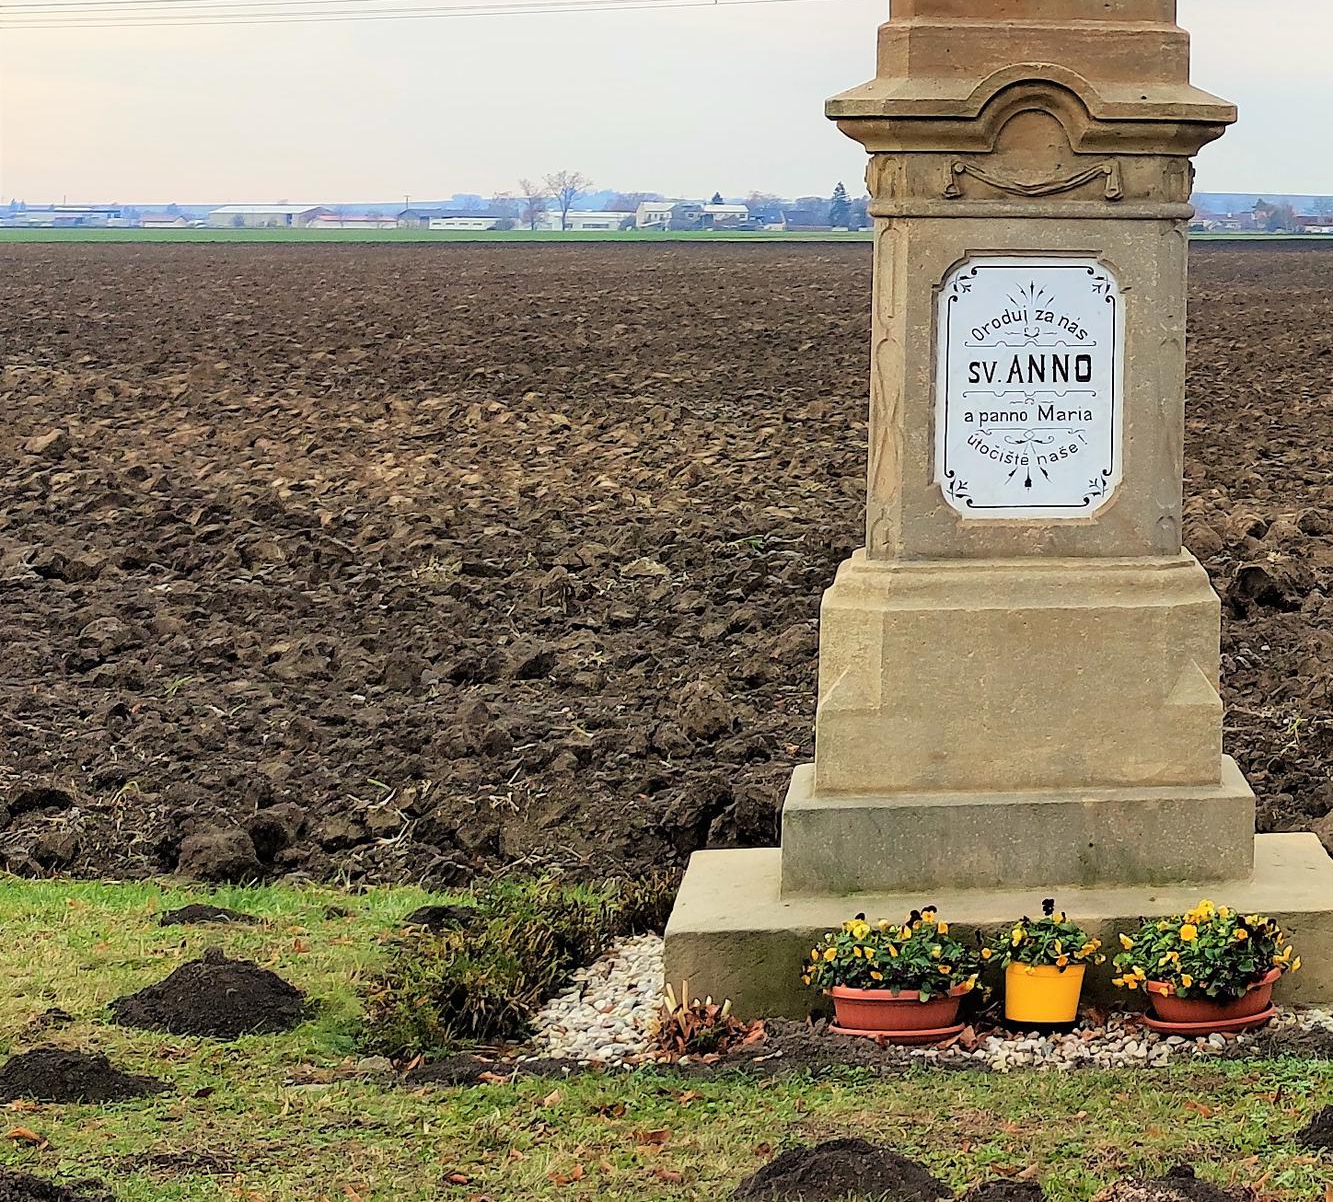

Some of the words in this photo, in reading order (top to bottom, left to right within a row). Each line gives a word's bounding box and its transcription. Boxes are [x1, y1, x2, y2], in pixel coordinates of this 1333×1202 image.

[1035, 309, 1055, 324] za
[1057, 316, 1088, 341] nás
[968, 361, 1002, 384] SV.
[1006, 353, 1092, 384] ANNO
[964, 411, 974, 422] a
[979, 411, 1028, 428] panno
[1038, 404, 1093, 422] Maria
[966, 433, 1029, 466] útočiště
